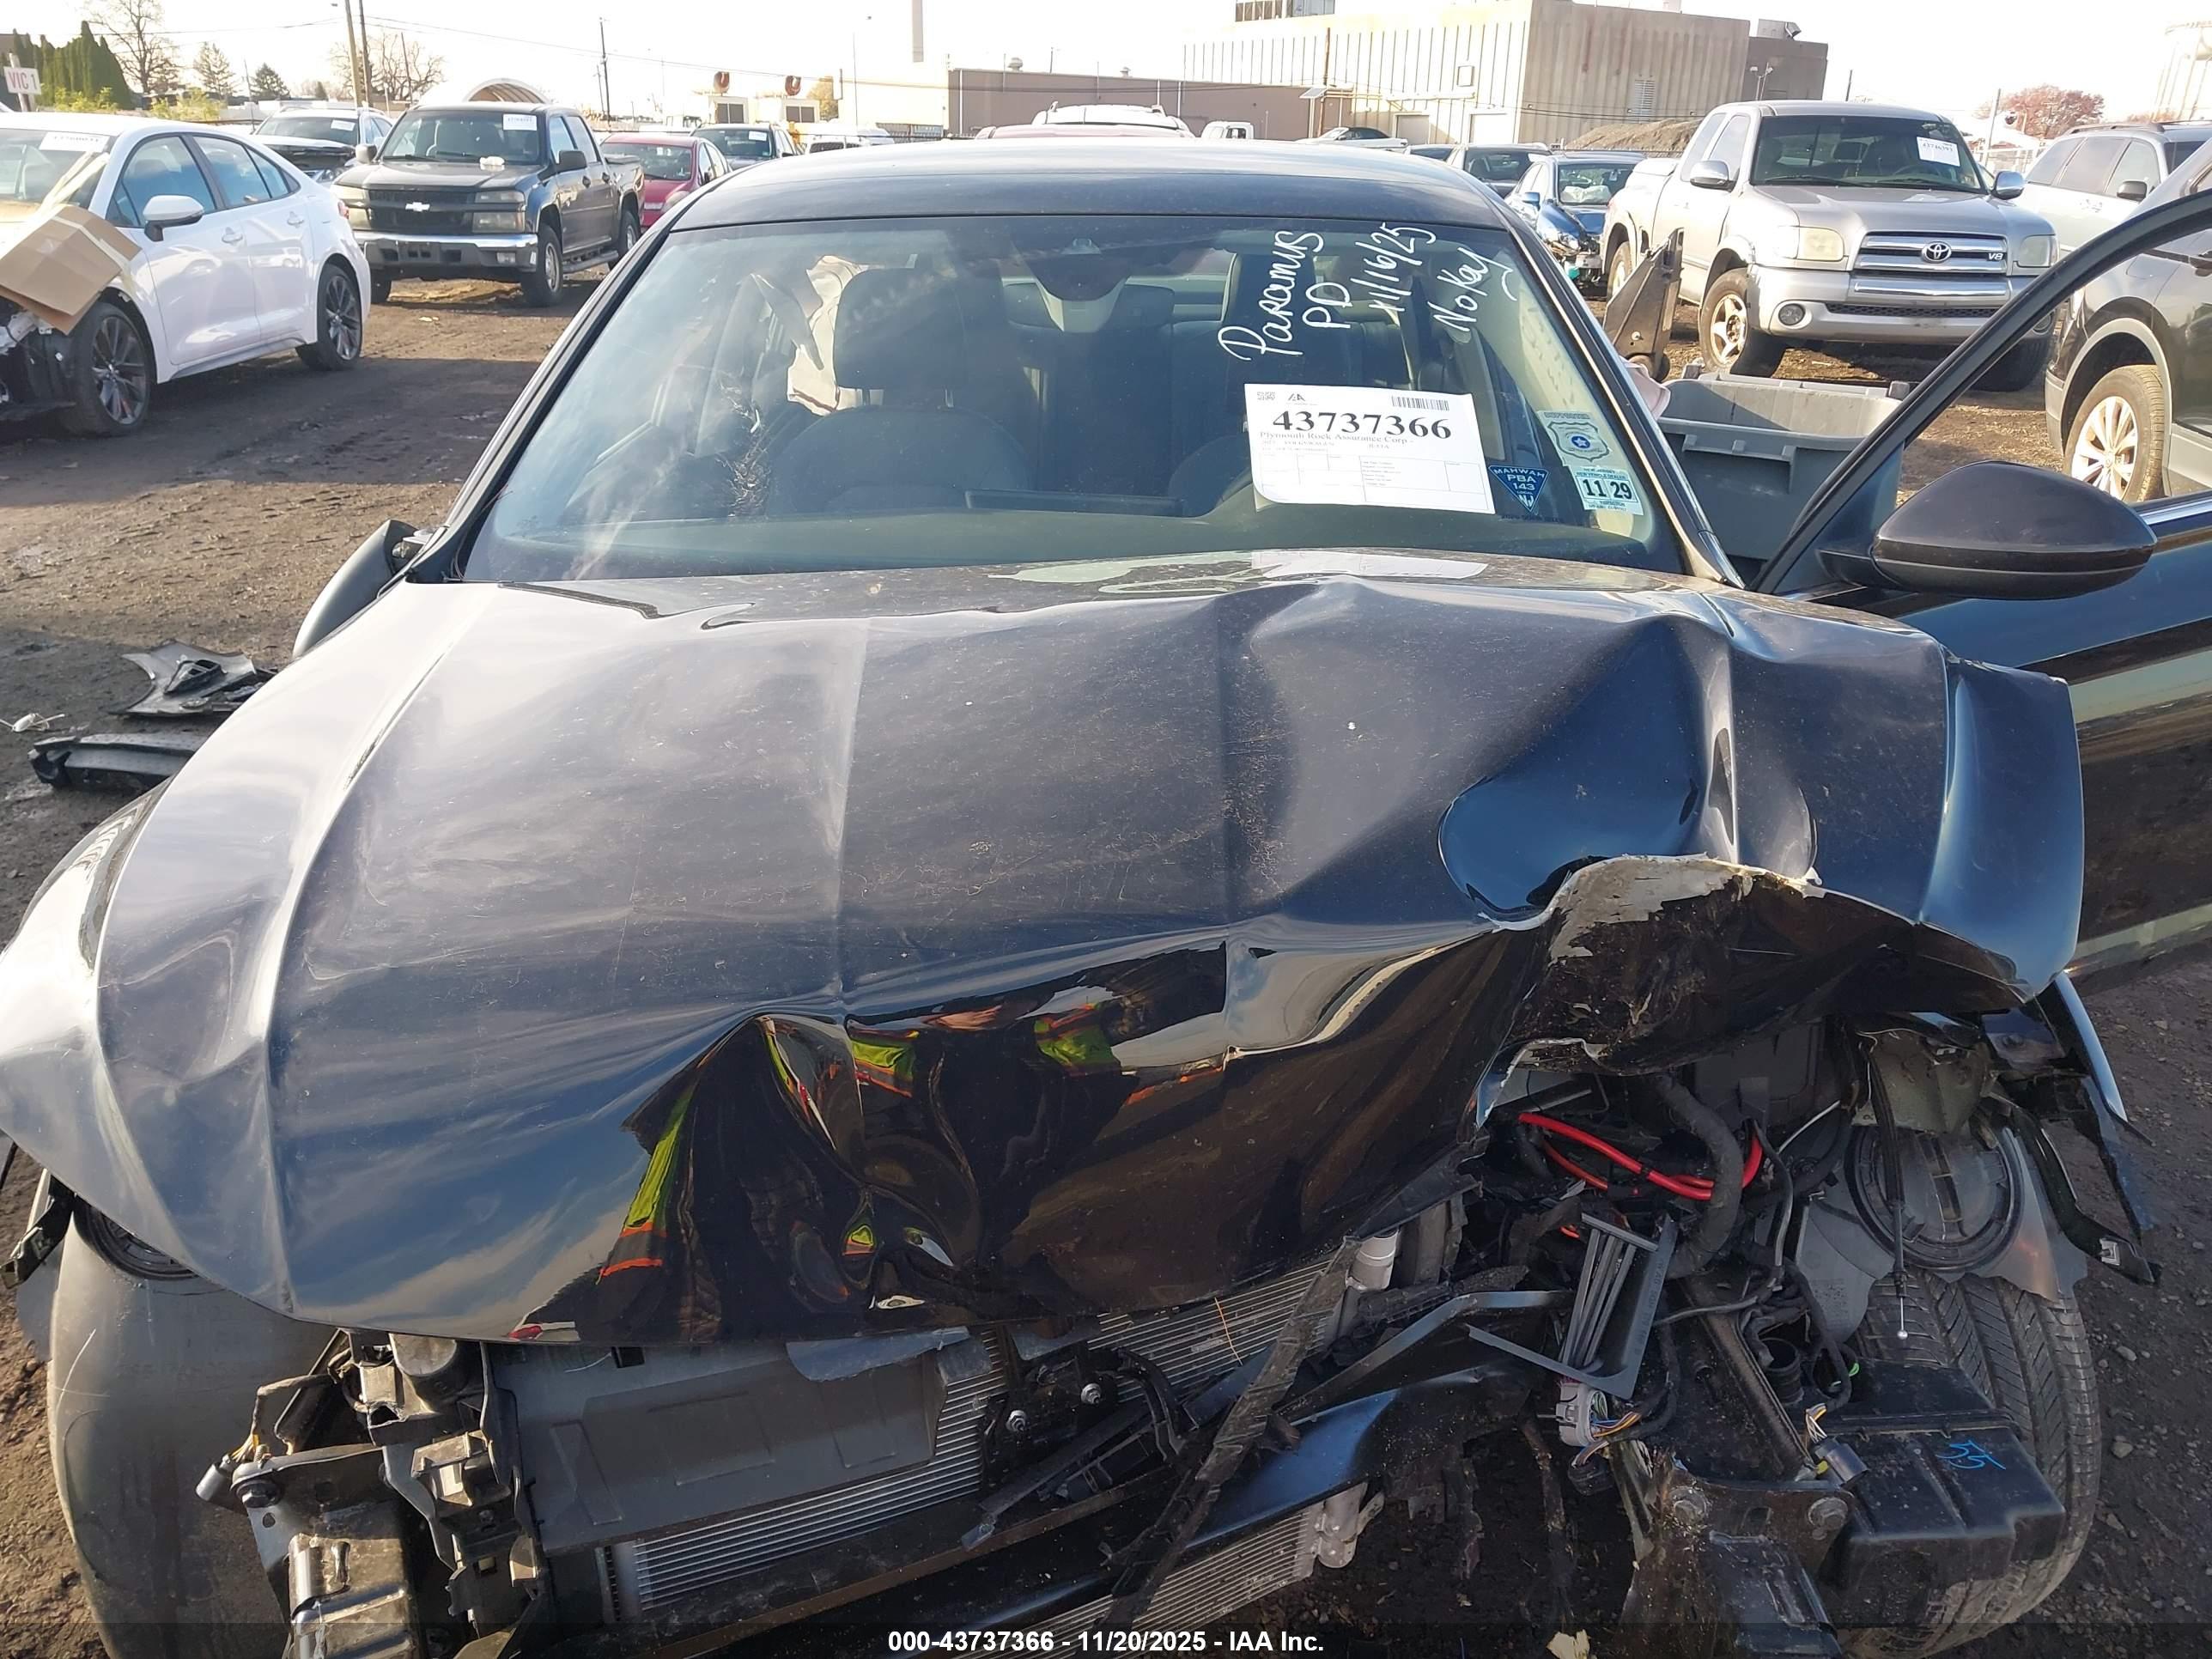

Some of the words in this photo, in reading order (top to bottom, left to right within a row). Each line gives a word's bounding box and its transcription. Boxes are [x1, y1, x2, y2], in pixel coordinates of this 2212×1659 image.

[8, 71, 28, 90] VIC
[1350, 222, 1437, 312] 11/16/25
[1302, 282, 1353, 329] PD
[1427, 295, 1478, 331] No
[1273, 410, 1451, 440] 43737366
[1494, 468, 1545, 478] MAHWAH
[1507, 474, 1536, 483] PBA
[1583, 479, 1607, 497] 11
[1610, 482, 1632, 500] 29
[1518, 495, 1534, 507] NJ
